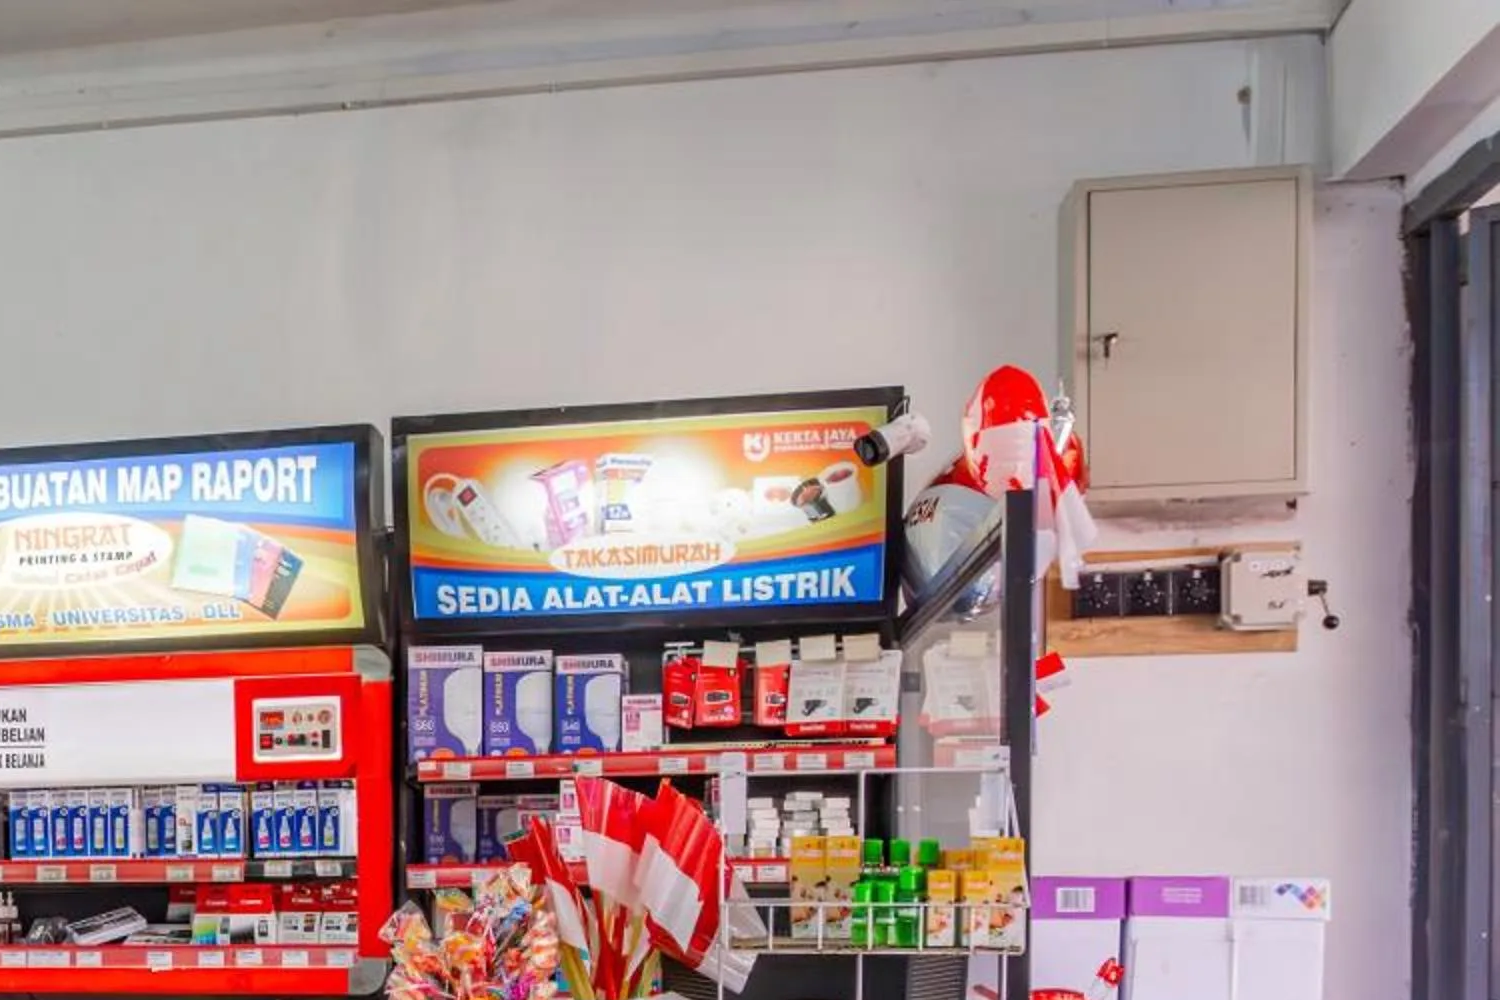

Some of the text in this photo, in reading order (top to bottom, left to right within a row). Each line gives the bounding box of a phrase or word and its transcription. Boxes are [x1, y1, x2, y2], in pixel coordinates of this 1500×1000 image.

[115, 464, 183, 503] MAP
[190, 455, 317, 503] RAPORT
[14, 524, 133, 550] NINGRAT
[19, 554, 77, 566] PRINTING
[93, 551, 134, 563] STAMP
[437, 566, 856, 613] SEDIA ALAT-ALAT LISTRIK
[52, 605, 184, 627] UNIVERSITAS
[204, 602, 240, 619] DLL
[5, 753, 45, 769] BELANJA
